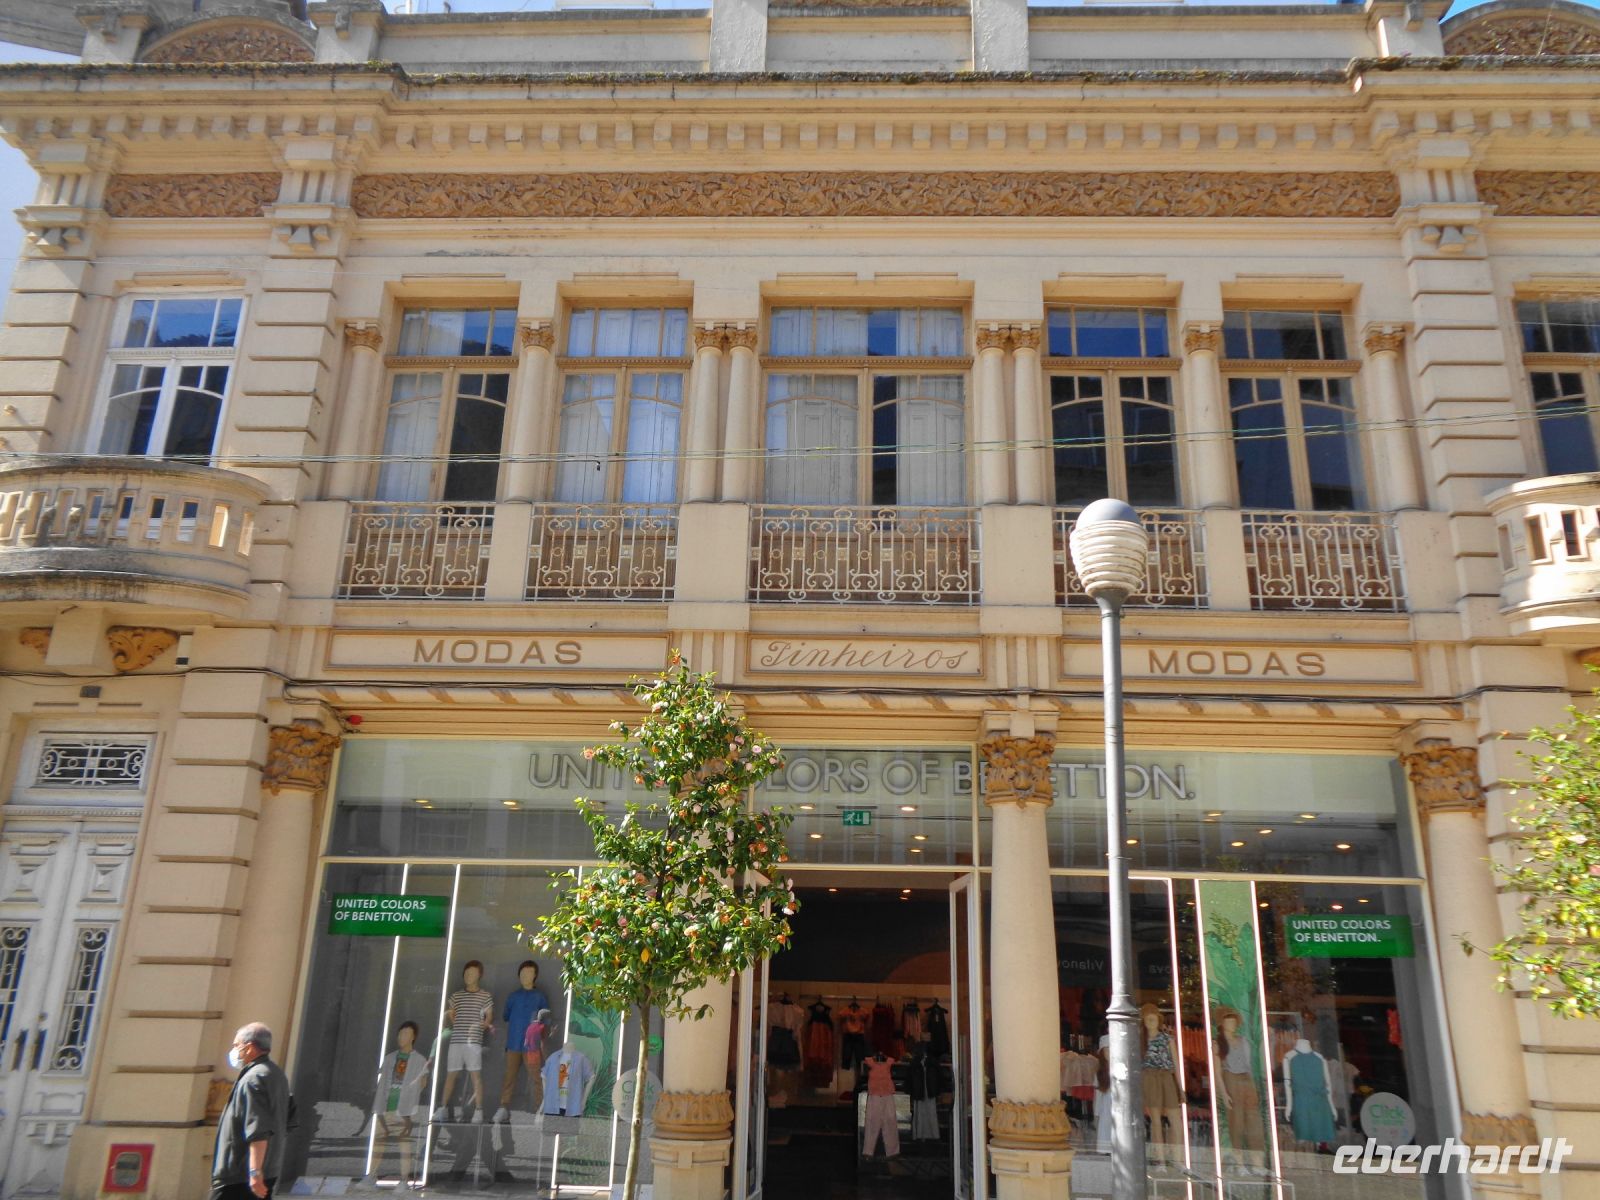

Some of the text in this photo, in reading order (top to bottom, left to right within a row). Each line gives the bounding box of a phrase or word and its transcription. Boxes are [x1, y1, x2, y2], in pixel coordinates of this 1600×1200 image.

[413, 638, 582, 665] MODAS
[1148, 649, 1326, 676] MODAS
[882, 759, 940, 795] OF
[336, 899, 426, 910] UNITED COLORS
[334, 911, 413, 922] OF BENETTON.
[1292, 920, 1391, 930] UNITED COLORS
[1294, 932, 1381, 943] OF BENETTON.
